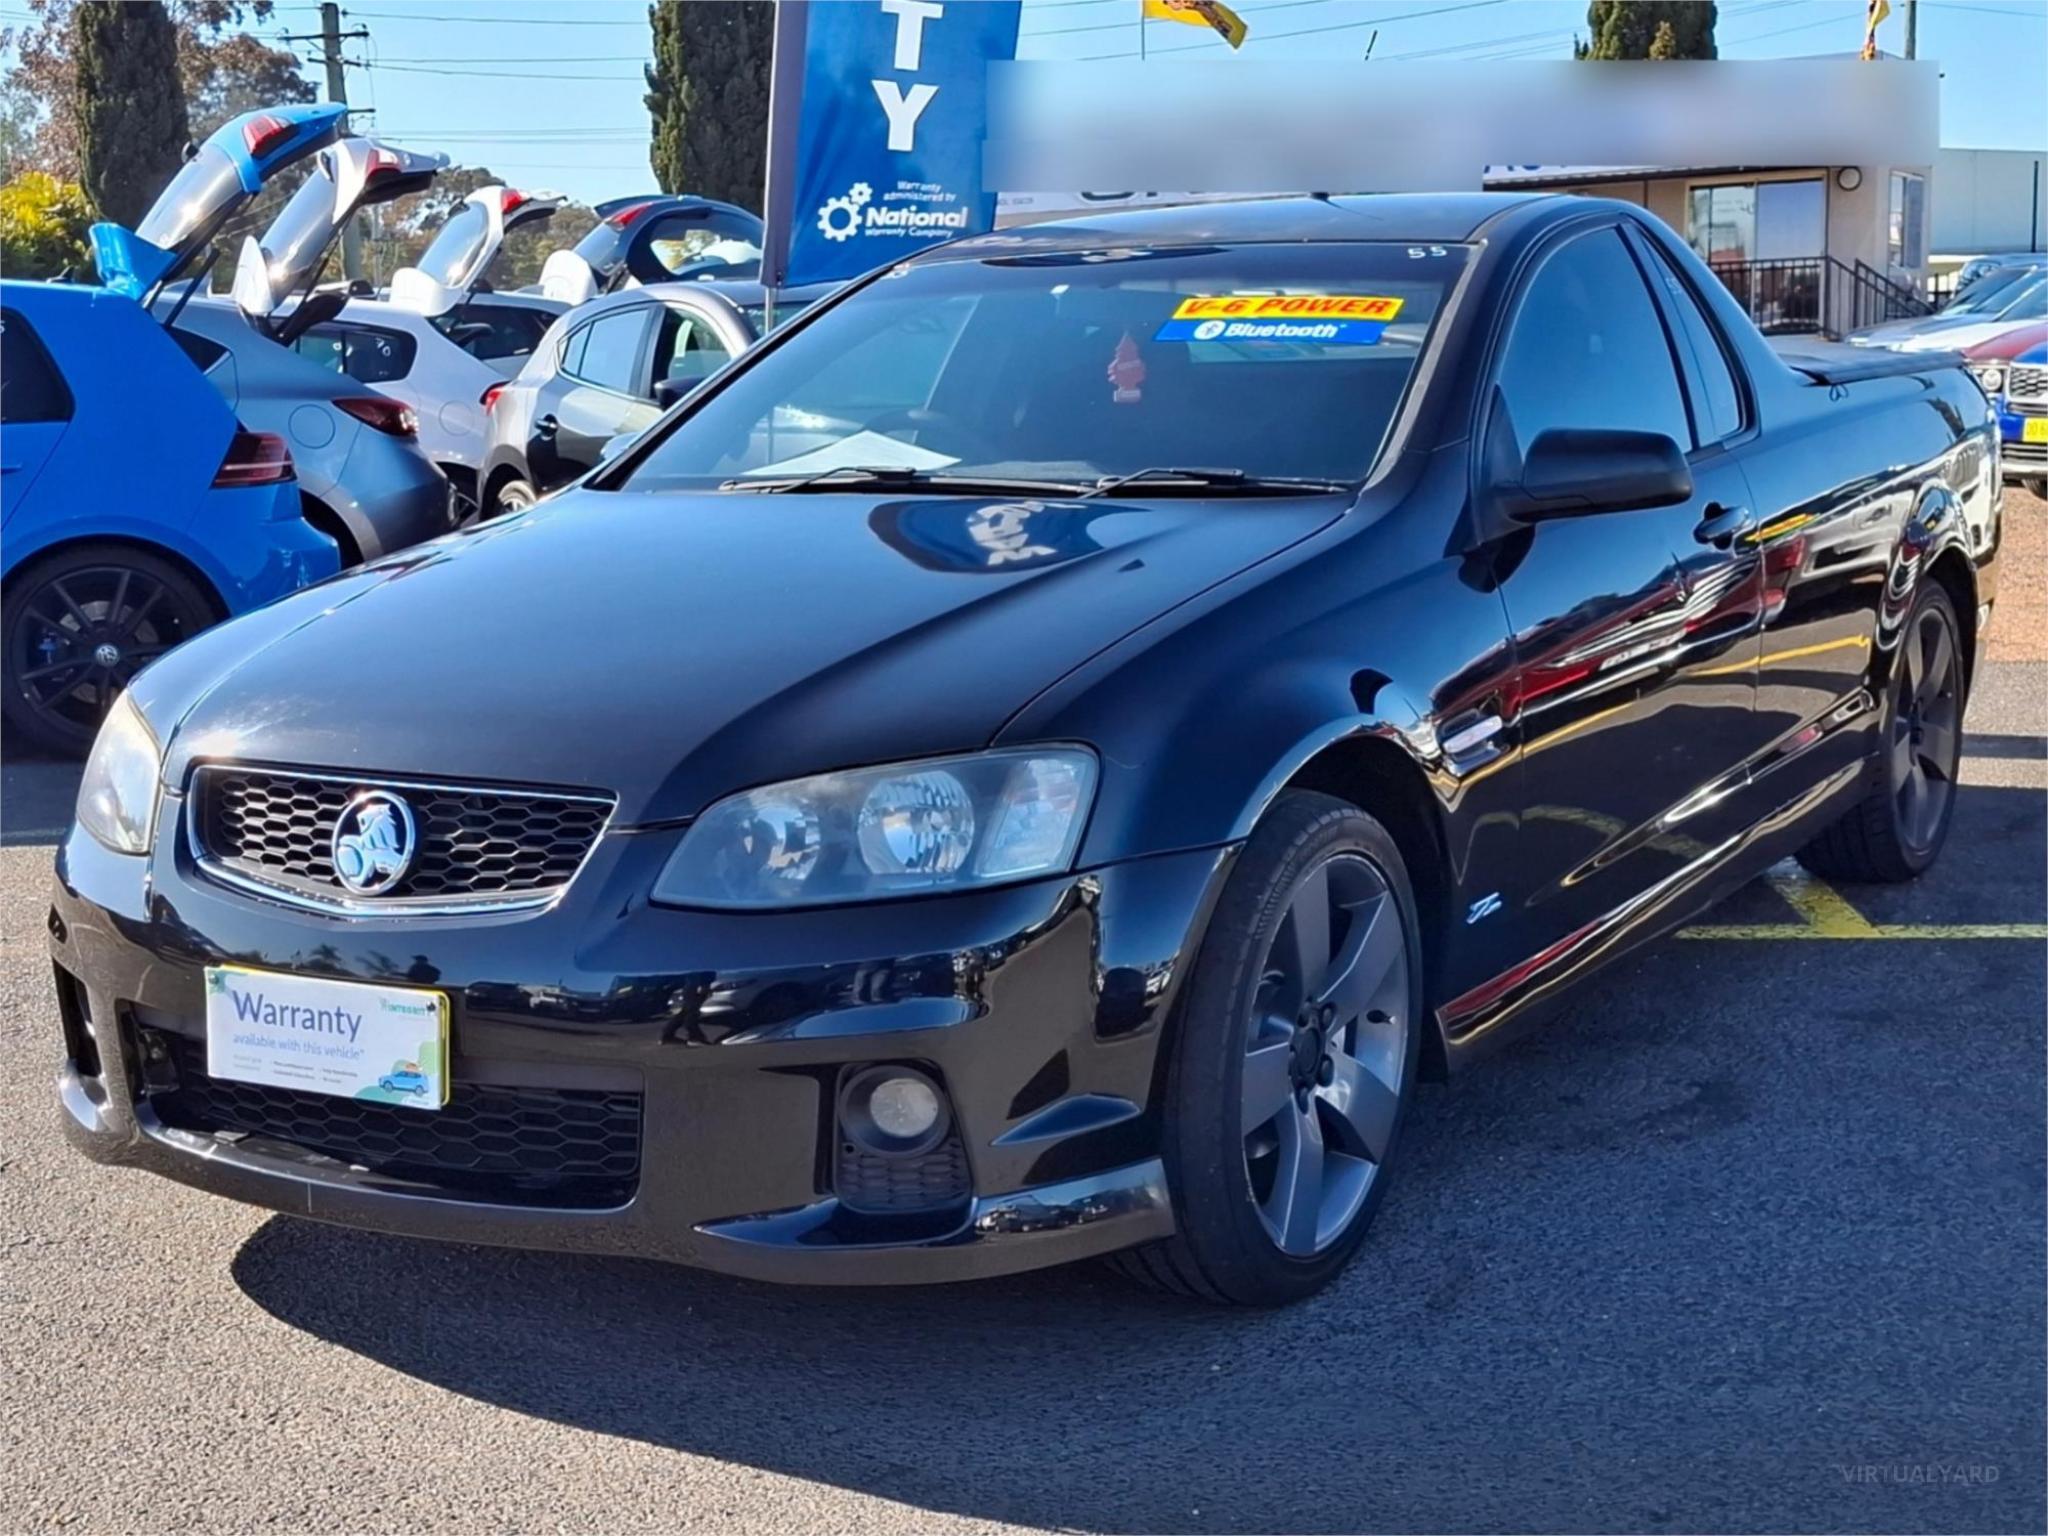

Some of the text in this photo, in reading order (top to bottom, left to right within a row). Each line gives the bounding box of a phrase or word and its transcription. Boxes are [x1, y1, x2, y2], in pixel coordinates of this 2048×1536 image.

[897, 181, 942, 193] Warranty
[865, 205, 968, 228] National
[908, 227, 954, 239] Company
[1183, 299, 1391, 316] V-6 POWER
[1223, 322, 1340, 339] Bluetooth
[232, 989, 362, 1043] Warranty
[233, 1032, 276, 1049] available
[278, 1037, 301, 1053] with
[303, 1040, 324, 1056] this
